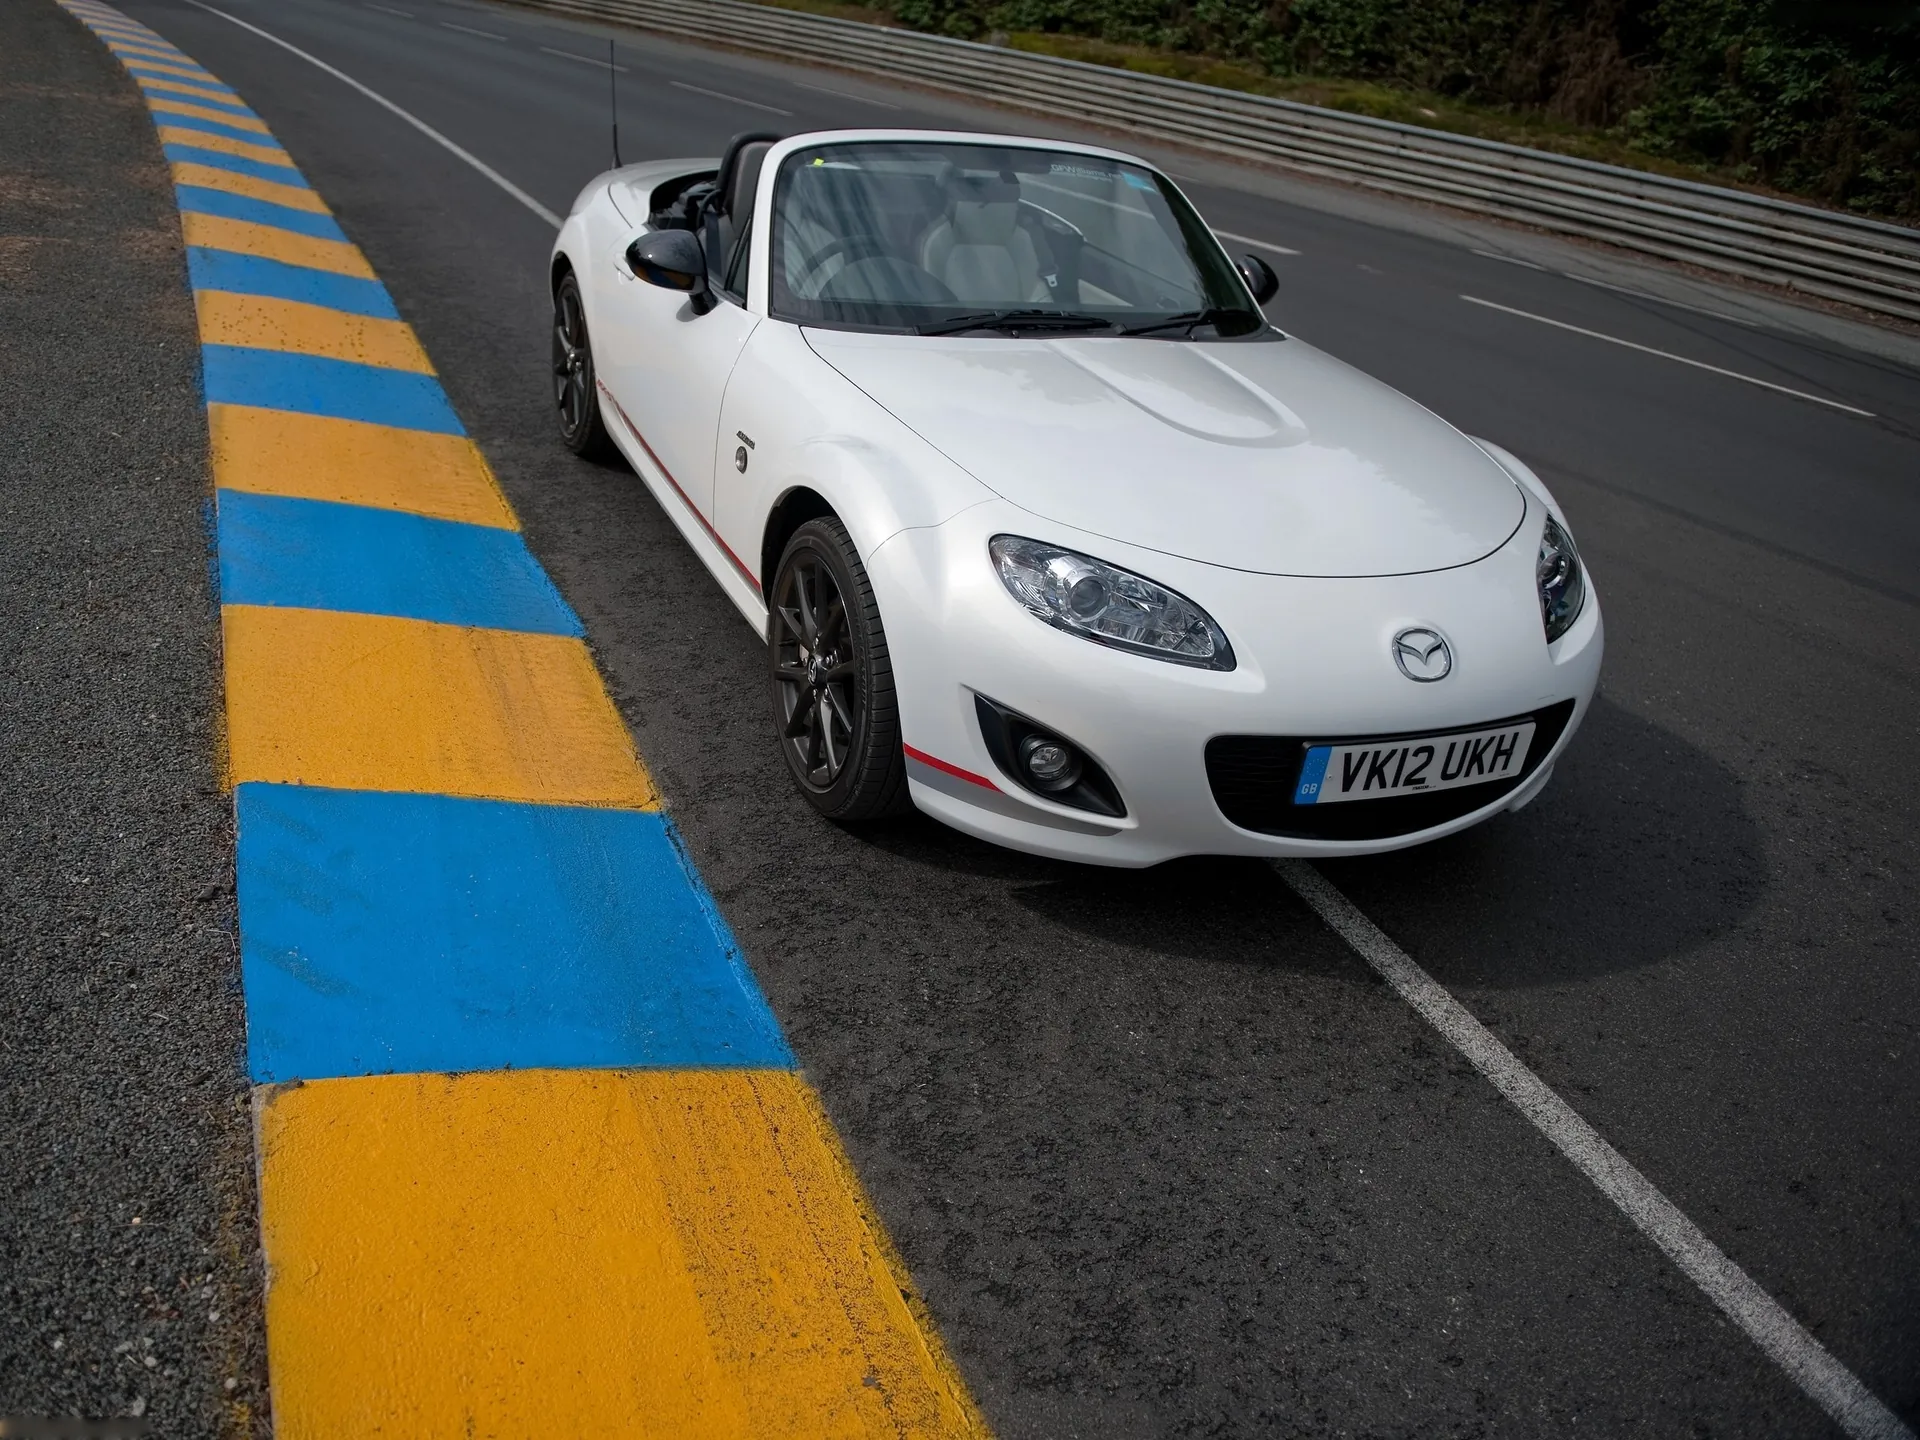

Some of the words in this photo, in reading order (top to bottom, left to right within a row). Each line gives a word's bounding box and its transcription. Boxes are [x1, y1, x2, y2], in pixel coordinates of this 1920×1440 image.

[1341, 745, 1435, 793] VK12
[1440, 732, 1520, 781] UKH
[1301, 783, 1318, 795] GB
